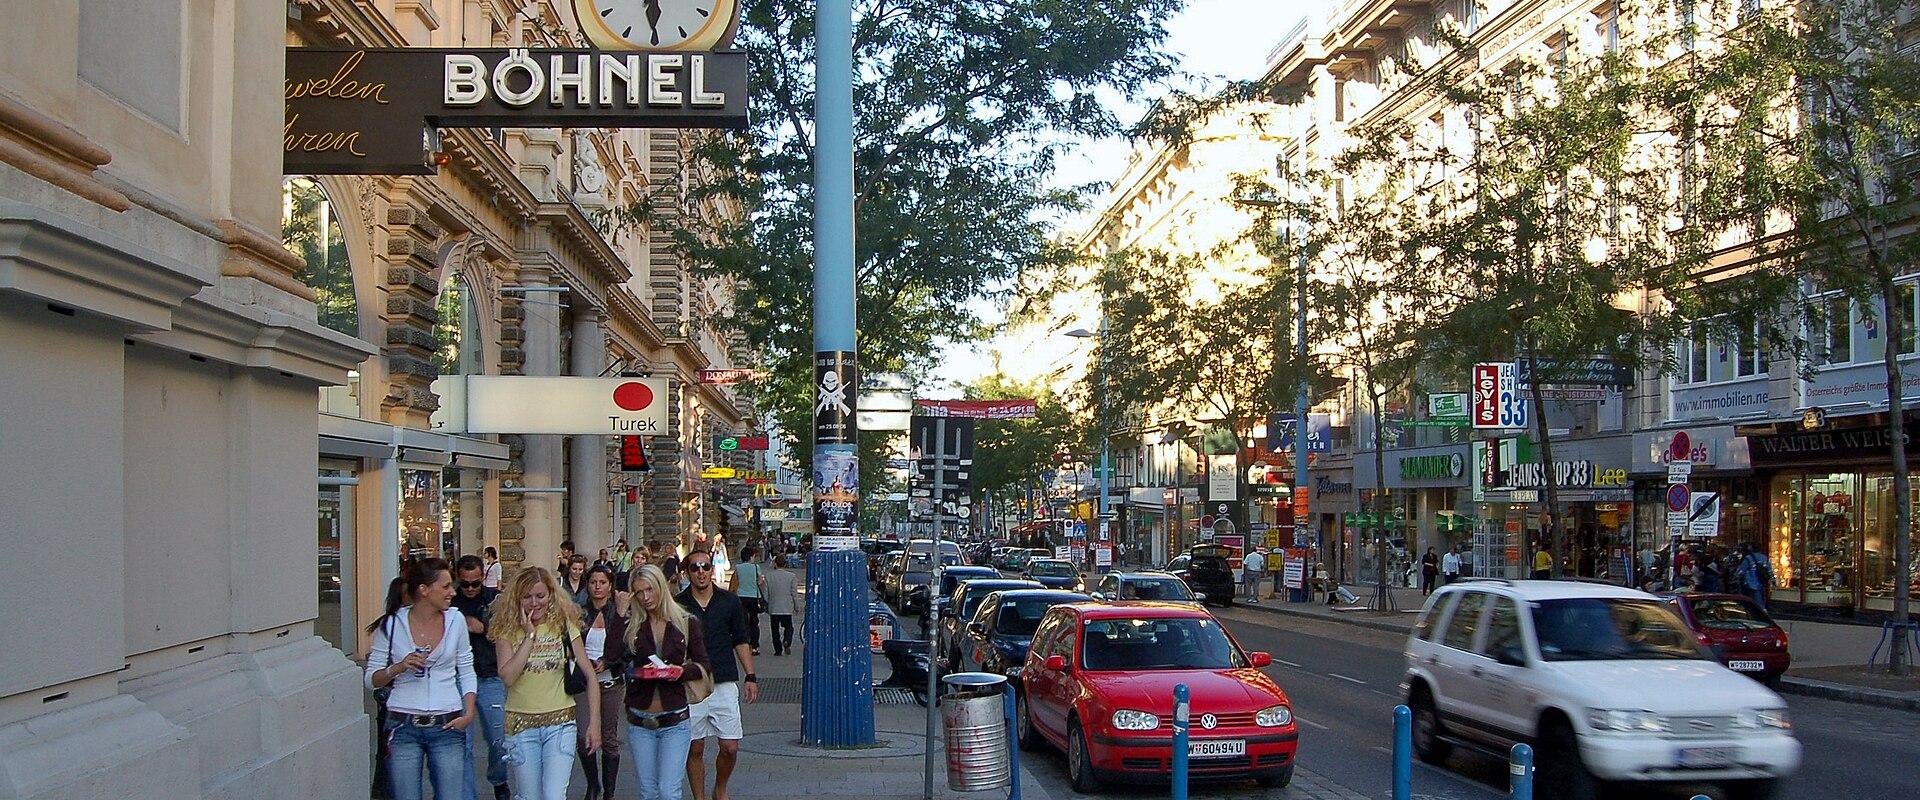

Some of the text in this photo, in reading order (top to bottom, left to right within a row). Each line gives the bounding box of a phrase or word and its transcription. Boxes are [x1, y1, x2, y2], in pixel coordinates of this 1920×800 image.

[284, 50, 389, 103] welen
[444, 49, 725, 106] BÖHNEL
[283, 112, 366, 156] hren
[1501, 365, 1516, 378] JEA
[1501, 378, 1517, 391] SH
[1501, 391, 1526, 427] 33
[1675, 391, 1770, 412] www.immobilien.ne
[608, 416, 658, 431] Turek
[1663, 443, 1707, 464] cle's
[1762, 433, 1836, 454] WALTER
[1400, 455, 1451, 479] SALAMANDER
[1506, 460, 1588, 487] JEANS SOP 33
[1593, 463, 1628, 485] Lee
